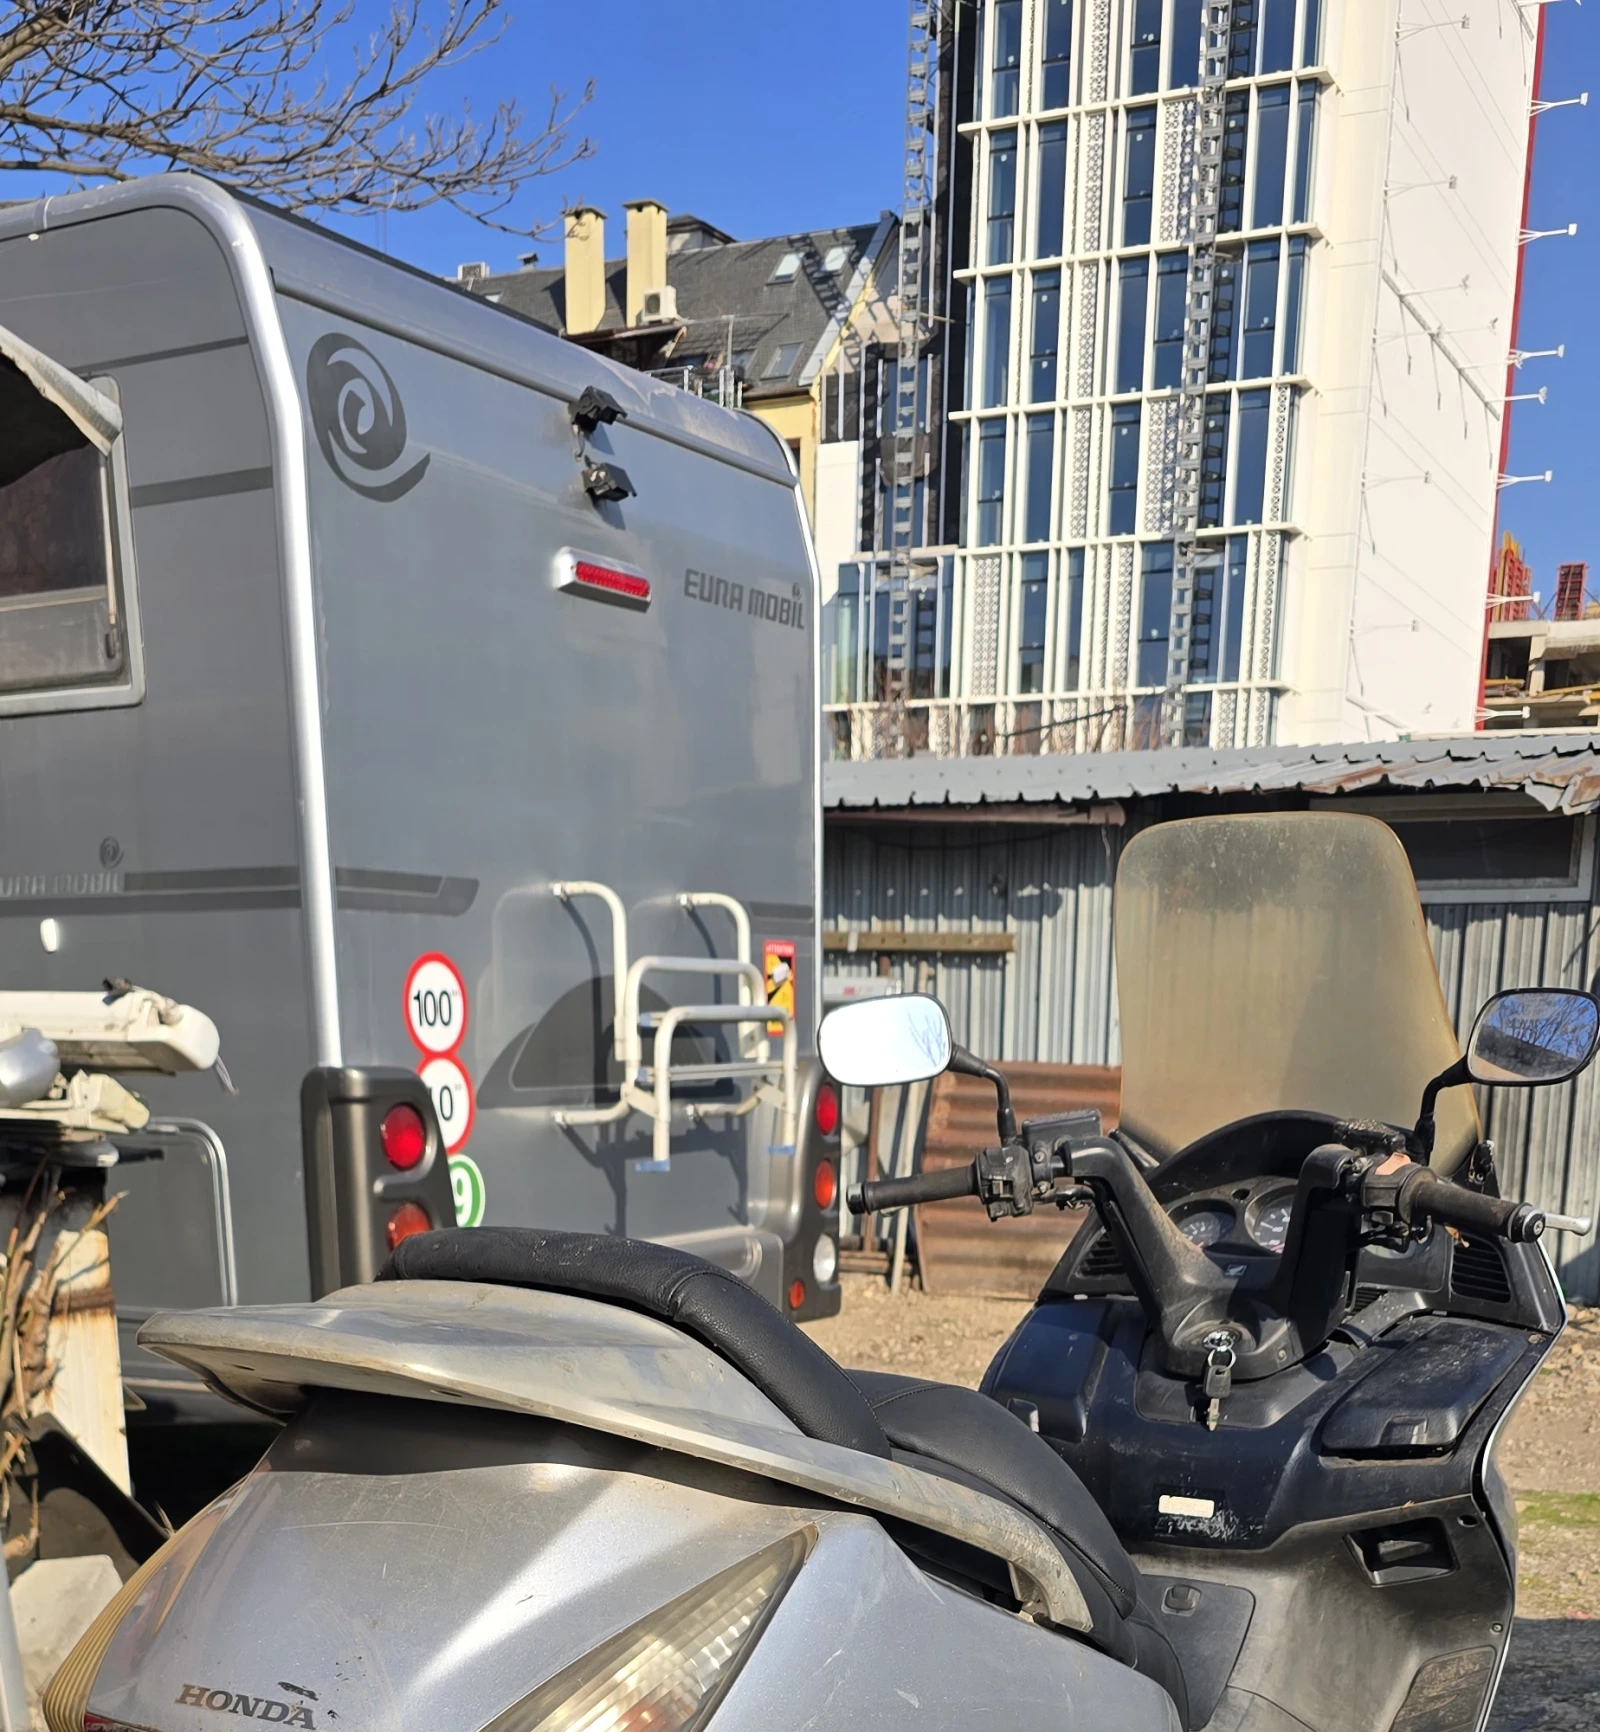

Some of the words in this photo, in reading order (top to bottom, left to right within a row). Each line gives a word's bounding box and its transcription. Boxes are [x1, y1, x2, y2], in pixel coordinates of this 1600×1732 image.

[683, 567, 744, 613] EURA
[747, 587, 805, 630] MOBIL
[412, 989, 452, 1027] 100
[429, 1084, 453, 1122] 0
[174, 1683, 317, 1731] HONDA
